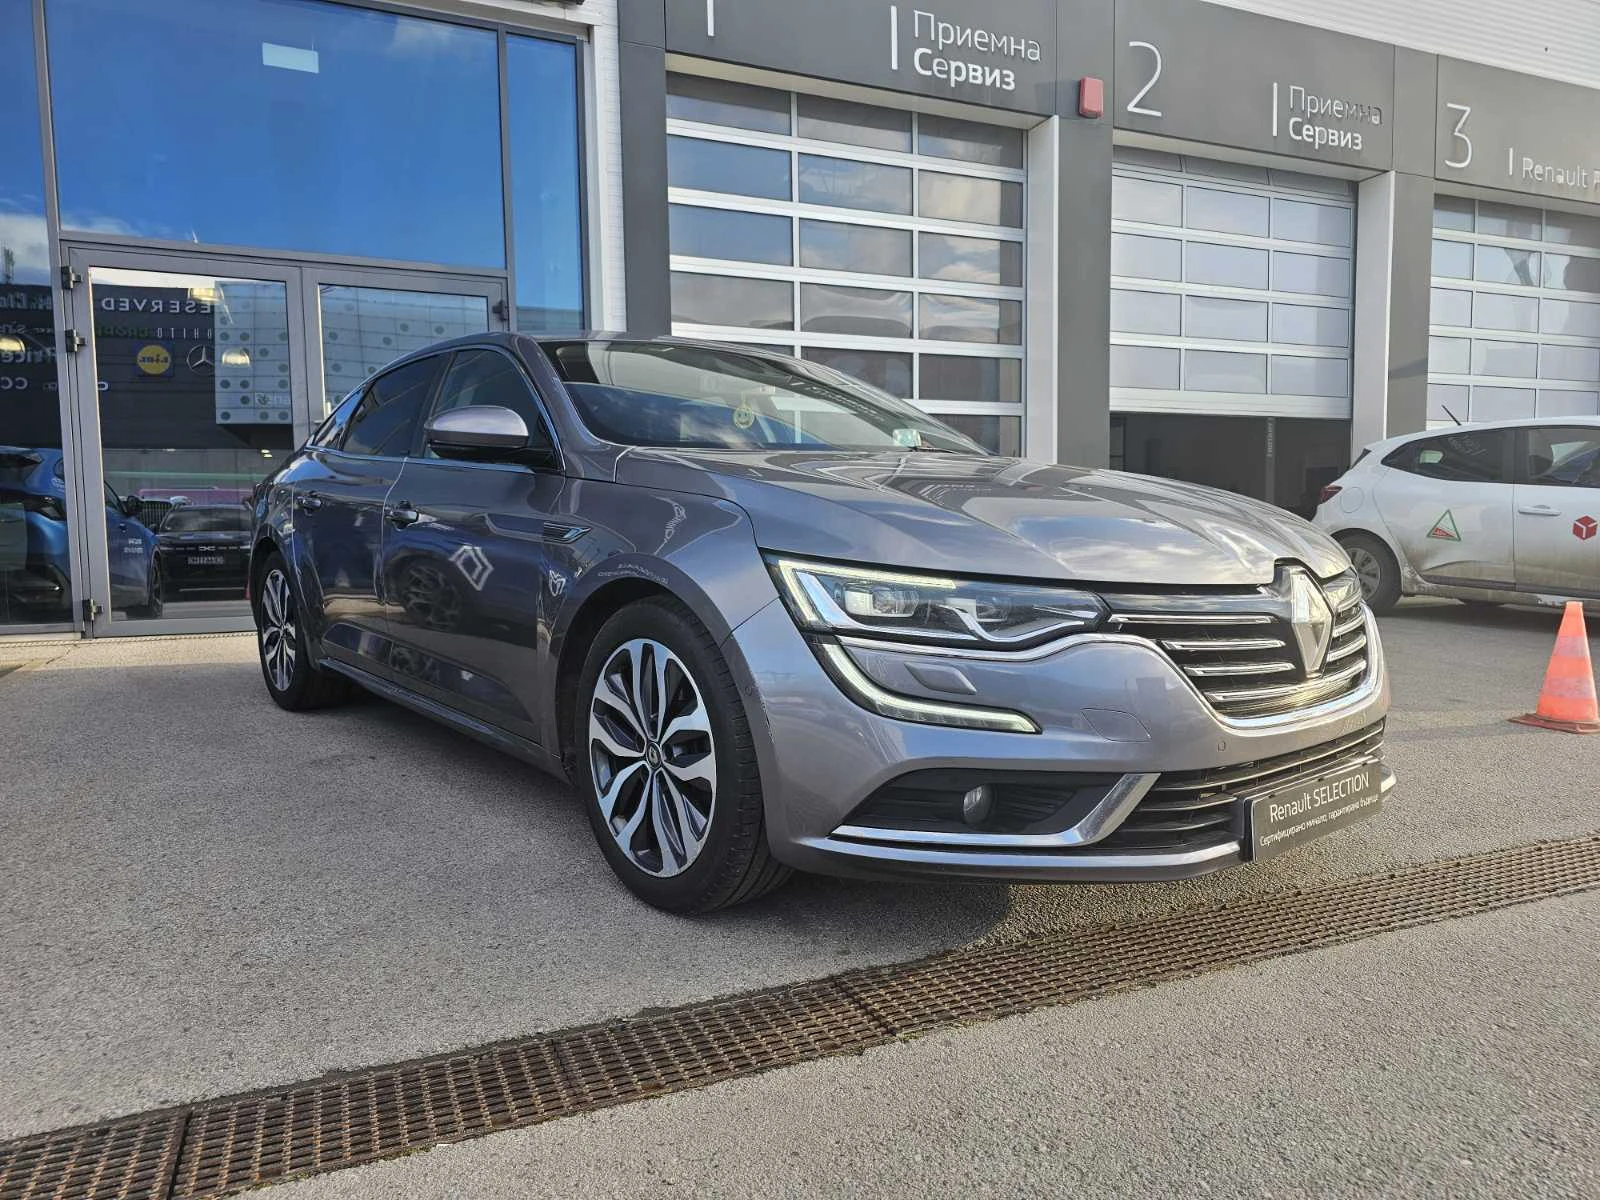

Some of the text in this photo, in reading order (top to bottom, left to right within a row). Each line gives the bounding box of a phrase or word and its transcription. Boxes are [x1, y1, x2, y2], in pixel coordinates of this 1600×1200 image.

[913, 10, 1041, 61] Приемна
[913, 47, 1016, 90] Сервиз
[1127, 41, 1163, 117] 2
[1289, 85, 1383, 125] Приемна
[1289, 117, 1362, 150] Сервиз
[1445, 102, 1473, 168] 3
[1522, 156, 1588, 188] Renault
[1270, 771, 1369, 823] Renault SELECTION
